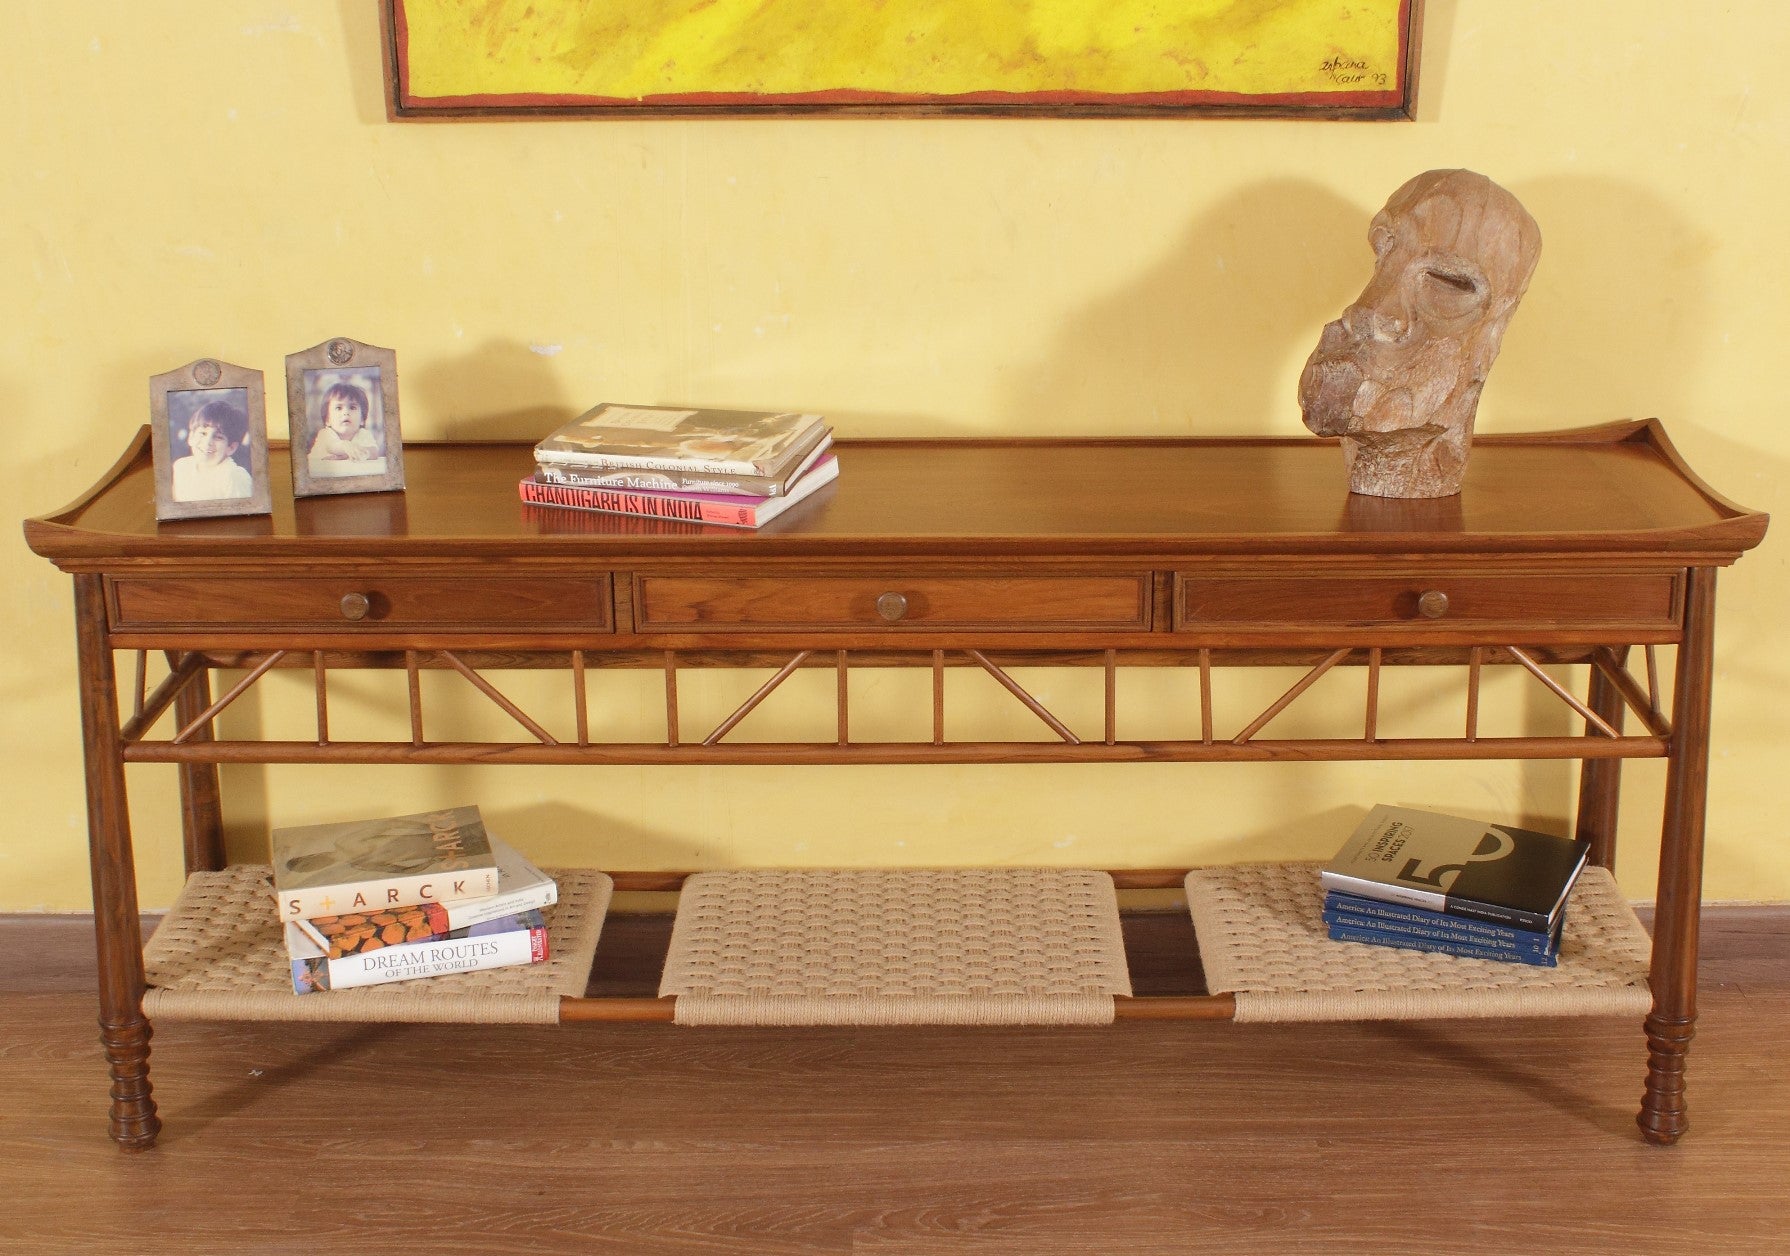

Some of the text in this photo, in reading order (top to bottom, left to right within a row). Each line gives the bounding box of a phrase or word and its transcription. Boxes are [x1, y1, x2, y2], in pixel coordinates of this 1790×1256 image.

[544, 472, 678, 489] The Furniture Machine
[601, 458, 737, 475] BRITISH COLONIAL STYLE
[525, 484, 621, 511] CHANDIGARH
[624, 494, 639, 513] IS
[641, 496, 658, 515] IN
[661, 498, 704, 520] INDIA
[1381, 838, 1406, 862] SPACES
[1336, 902, 1364, 913] America:
[1366, 904, 1376, 914] An
[1377, 909, 1411, 920] Illustrated
[1412, 914, 1431, 925] Diary
[1440, 918, 1449, 927] Its
[1450, 921, 1467, 930] Most
[1468, 923, 1496, 936] Exciting
[1496, 927, 1514, 938] Years
[1336, 916, 1364, 926] America:
[1366, 918, 1377, 928] An
[1378, 921, 1411, 933] Illustrated
[1412, 926, 1431, 937] Diary
[1441, 930, 1450, 939] Its
[1451, 932, 1468, 942] Most
[1469, 935, 1497, 947] Exciting
[1497, 939, 1516, 949] Years
[363, 942, 498, 970] DREAM ROUTES
[1341, 933, 1369, 942] America:
[1371, 935, 1381, 943] An
[1382, 938, 1416, 948] Illustrated
[1418, 942, 1435, 952] Diary
[1456, 947, 1473, 955] Most
[1475, 948, 1503, 960] Exciting
[1504, 952, 1522, 961] Years
[385, 958, 478, 978] OF THE WORLD
